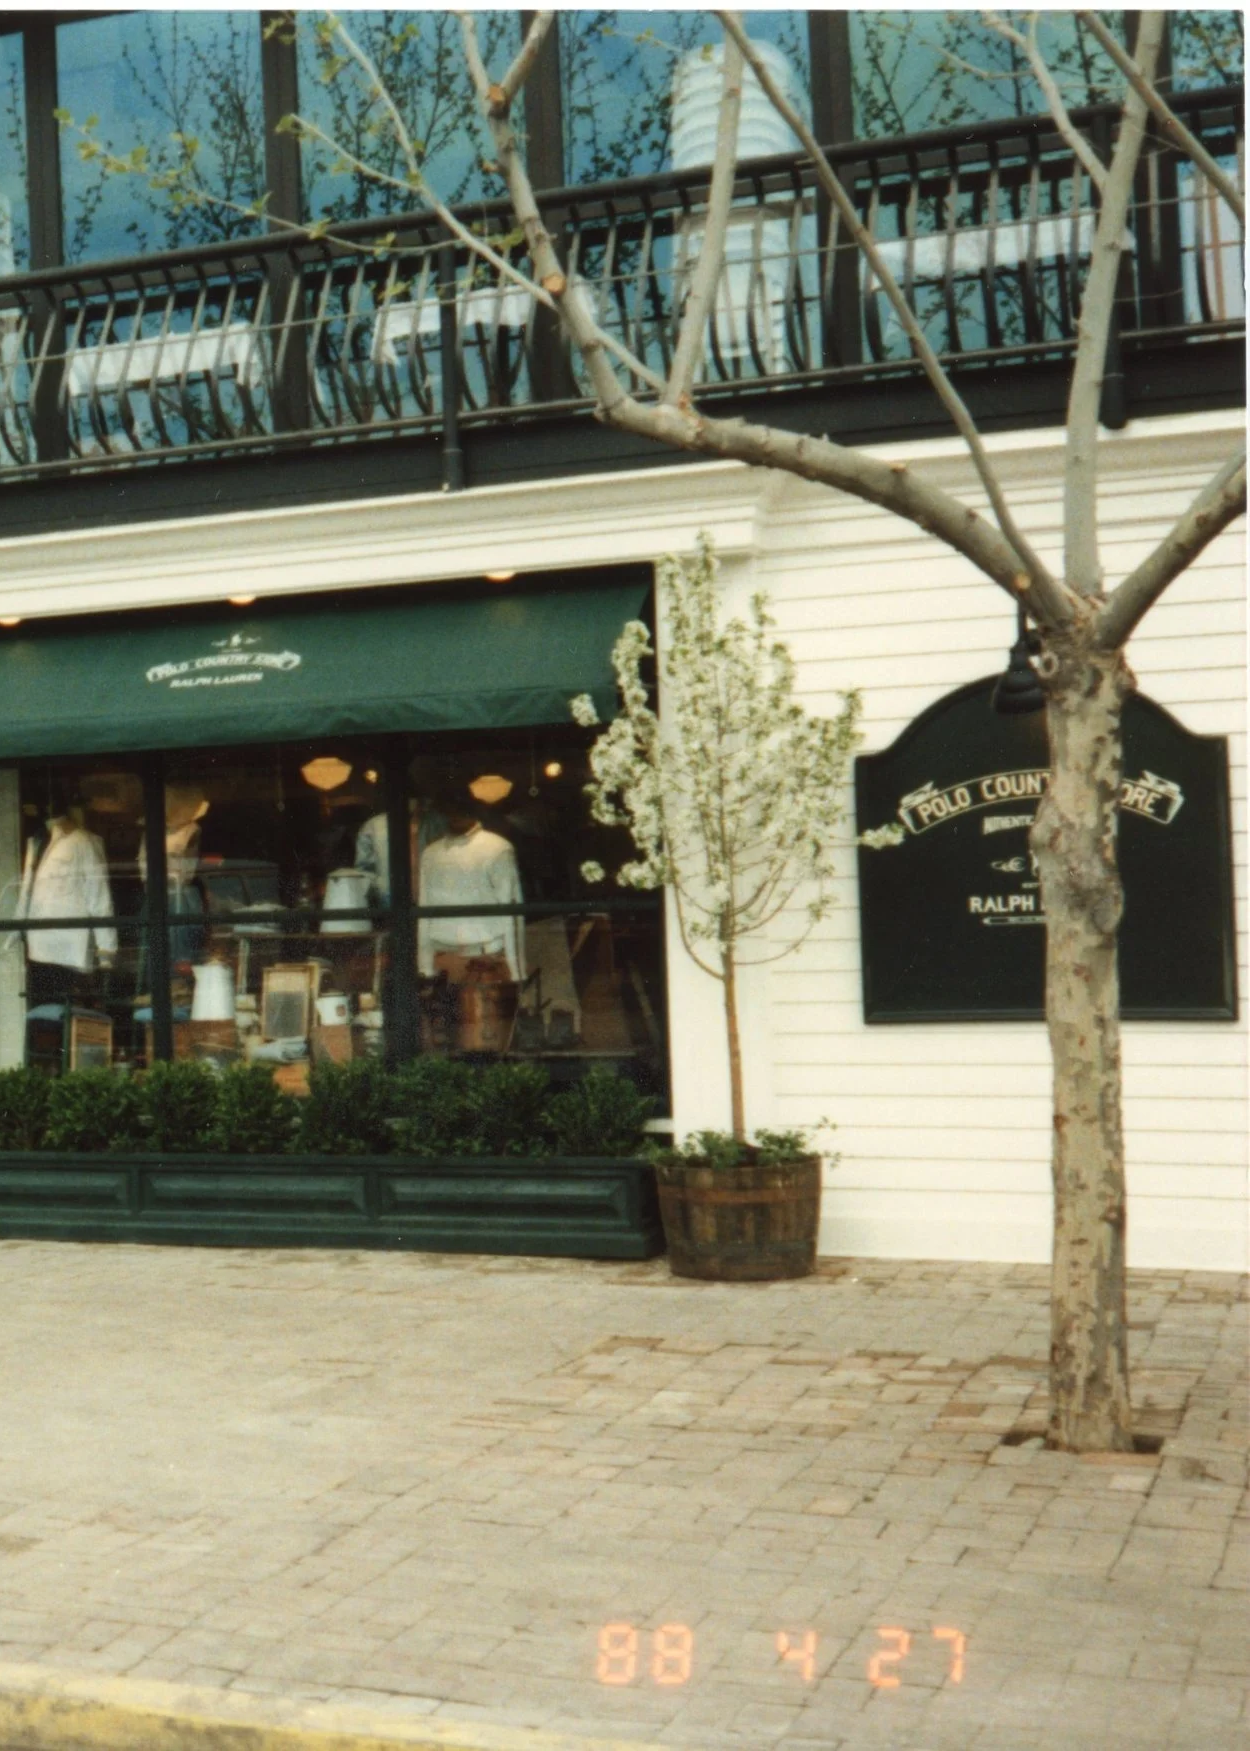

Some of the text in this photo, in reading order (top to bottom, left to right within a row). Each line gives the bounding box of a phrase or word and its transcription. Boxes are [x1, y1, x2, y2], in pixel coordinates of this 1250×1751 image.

[917, 787, 971, 824] POLO
[1120, 783, 1163, 813] ORE
[969, 895, 1035, 913] RALPH
